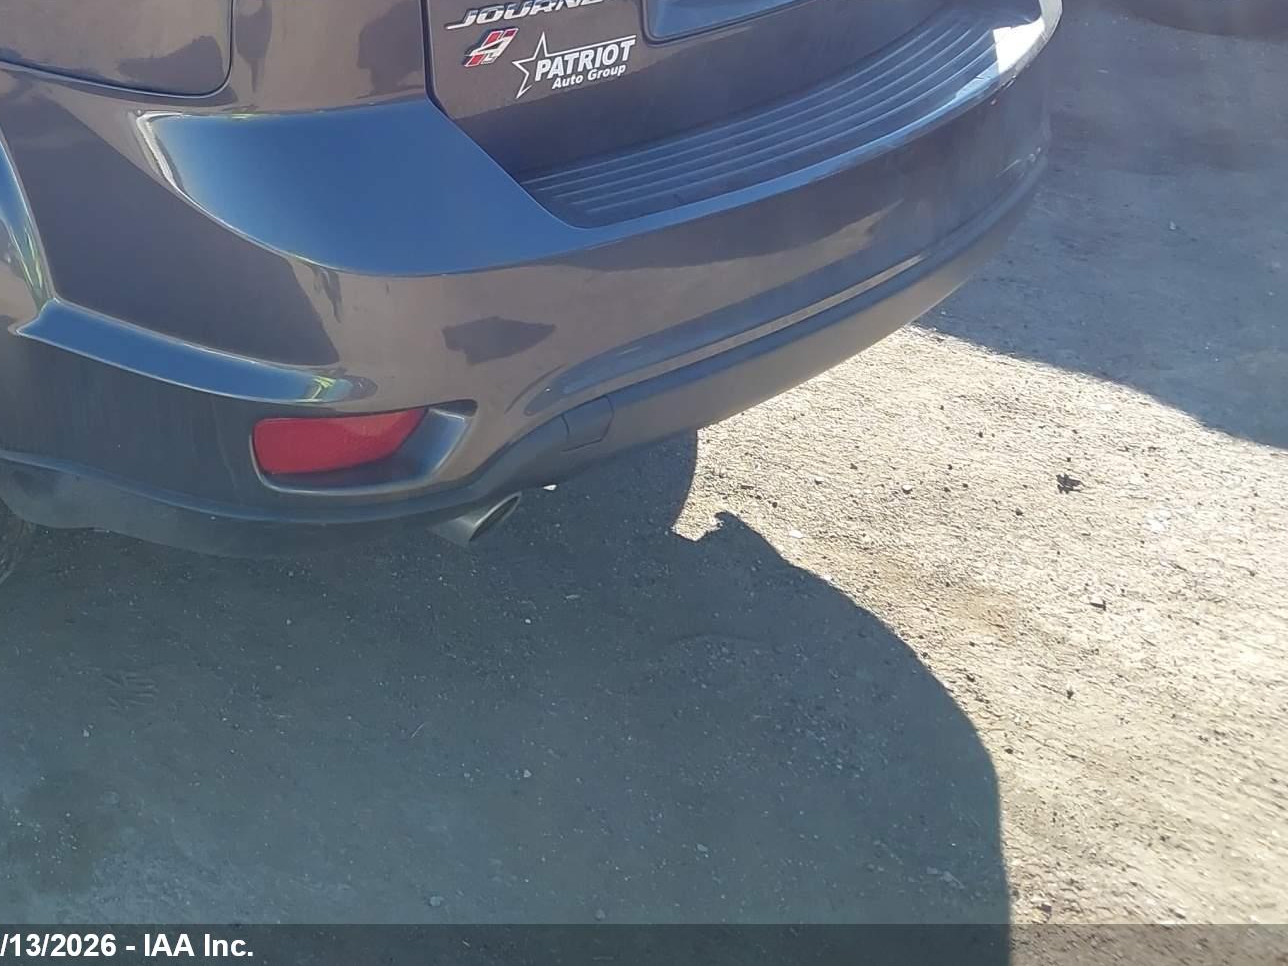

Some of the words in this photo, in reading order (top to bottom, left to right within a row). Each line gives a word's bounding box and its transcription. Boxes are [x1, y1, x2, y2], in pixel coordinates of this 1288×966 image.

[534, 38, 636, 83] PATRIOT
[552, 73, 584, 89] Auto
[586, 63, 627, 82] Group
